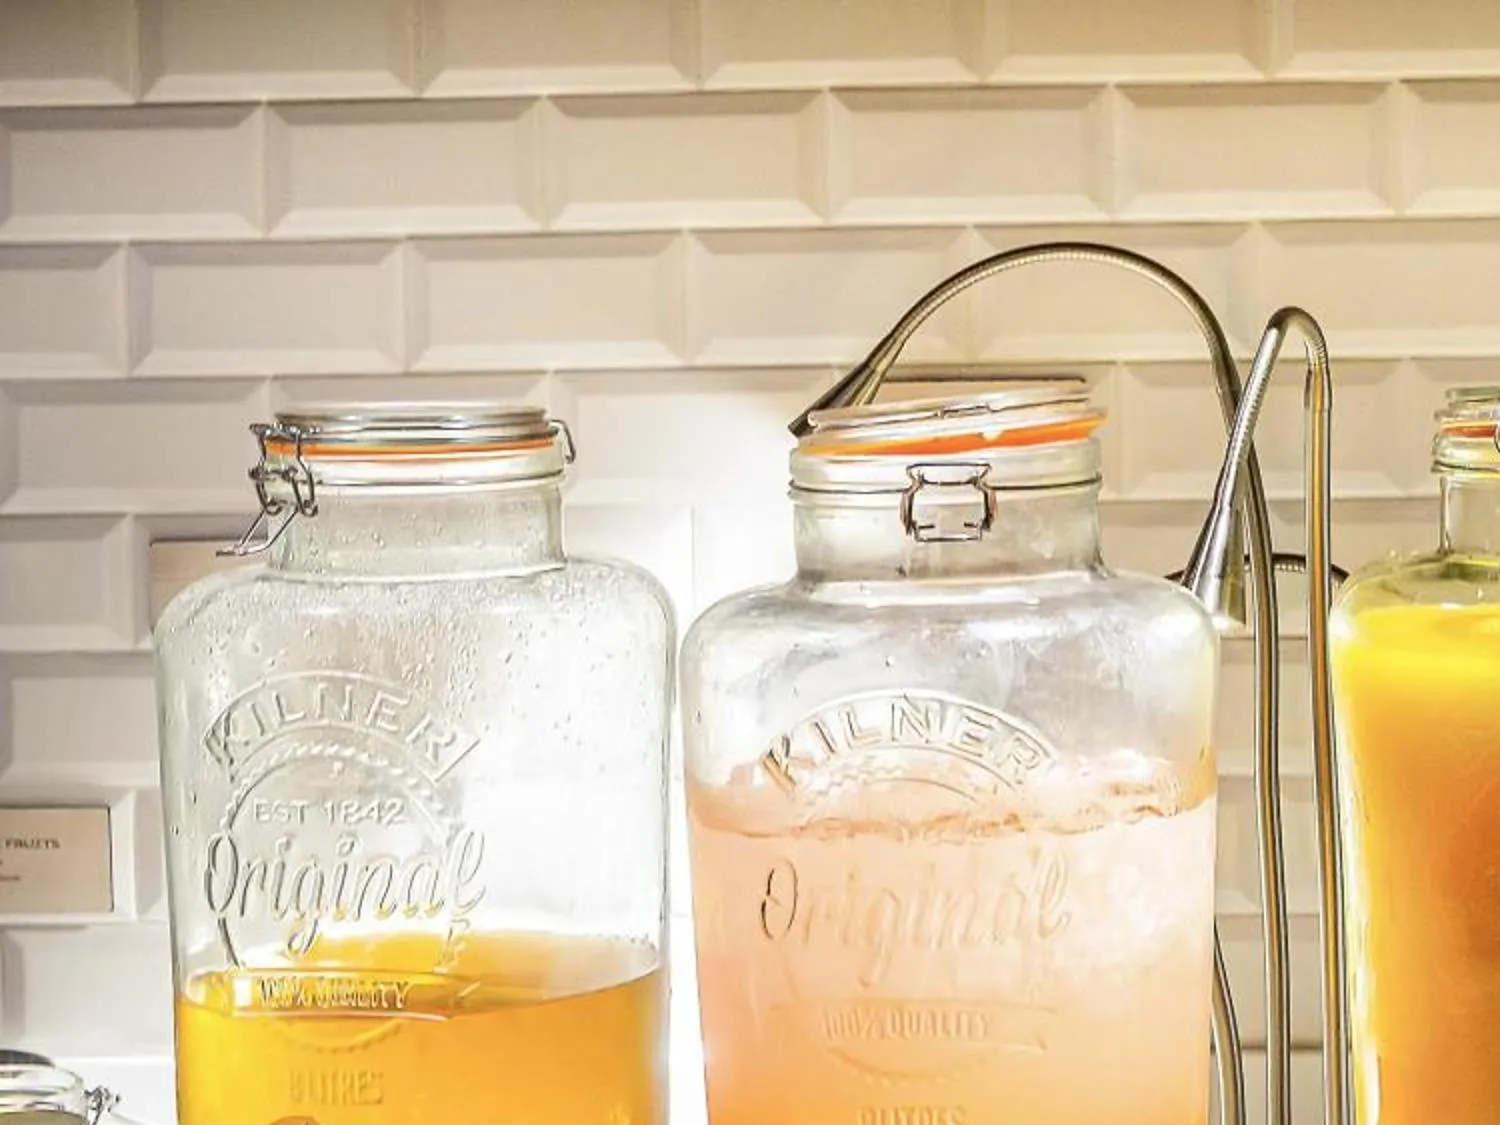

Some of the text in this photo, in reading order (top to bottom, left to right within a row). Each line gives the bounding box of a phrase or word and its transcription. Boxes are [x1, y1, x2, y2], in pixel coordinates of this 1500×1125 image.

[208, 683, 457, 768] KILNER
[760, 694, 1046, 796] KILNER
[5, 837, 61, 850] FRUITS
[253, 800, 406, 826] EST 1842
[205, 829, 487, 955] Original
[760, 846, 1075, 989] Original
